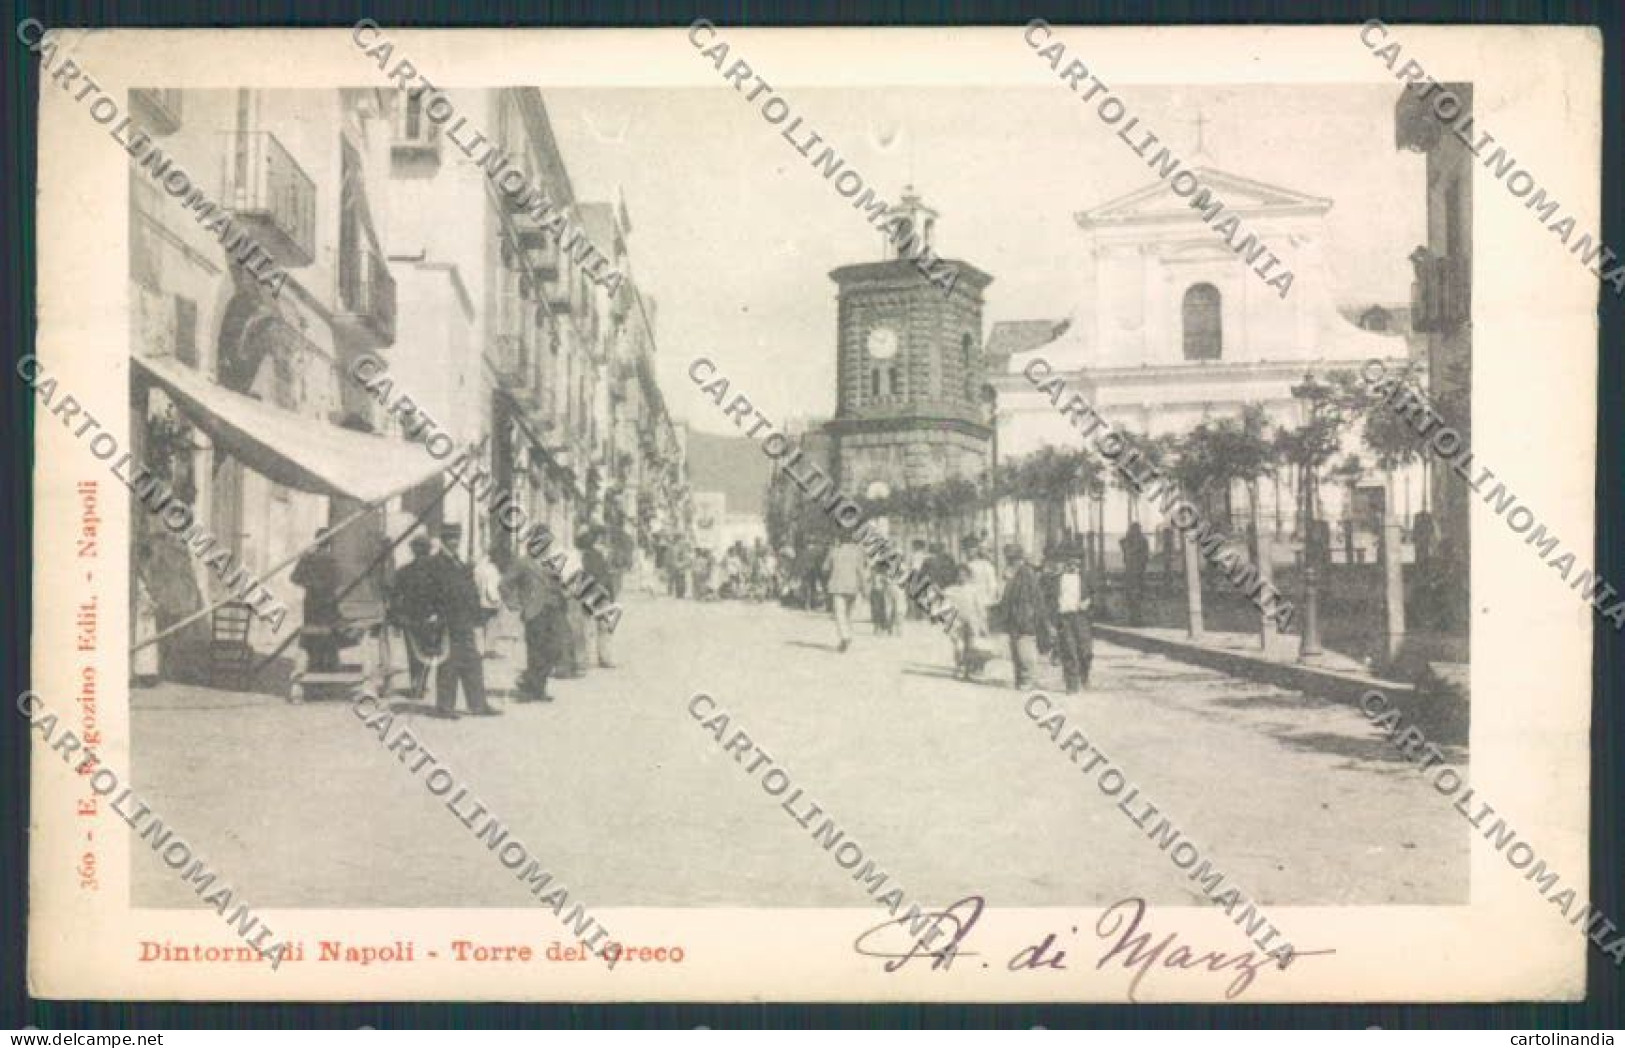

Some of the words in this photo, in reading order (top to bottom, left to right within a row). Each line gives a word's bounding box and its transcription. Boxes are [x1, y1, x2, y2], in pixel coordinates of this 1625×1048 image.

[77, 480, 101, 557] Napoli
[77, 596, 97, 652] Edit.
[138, 941, 263, 962] Dintorni
[318, 941, 414, 965] Napoli
[452, 941, 532, 962] Torre
[546, 941, 588, 962] del
